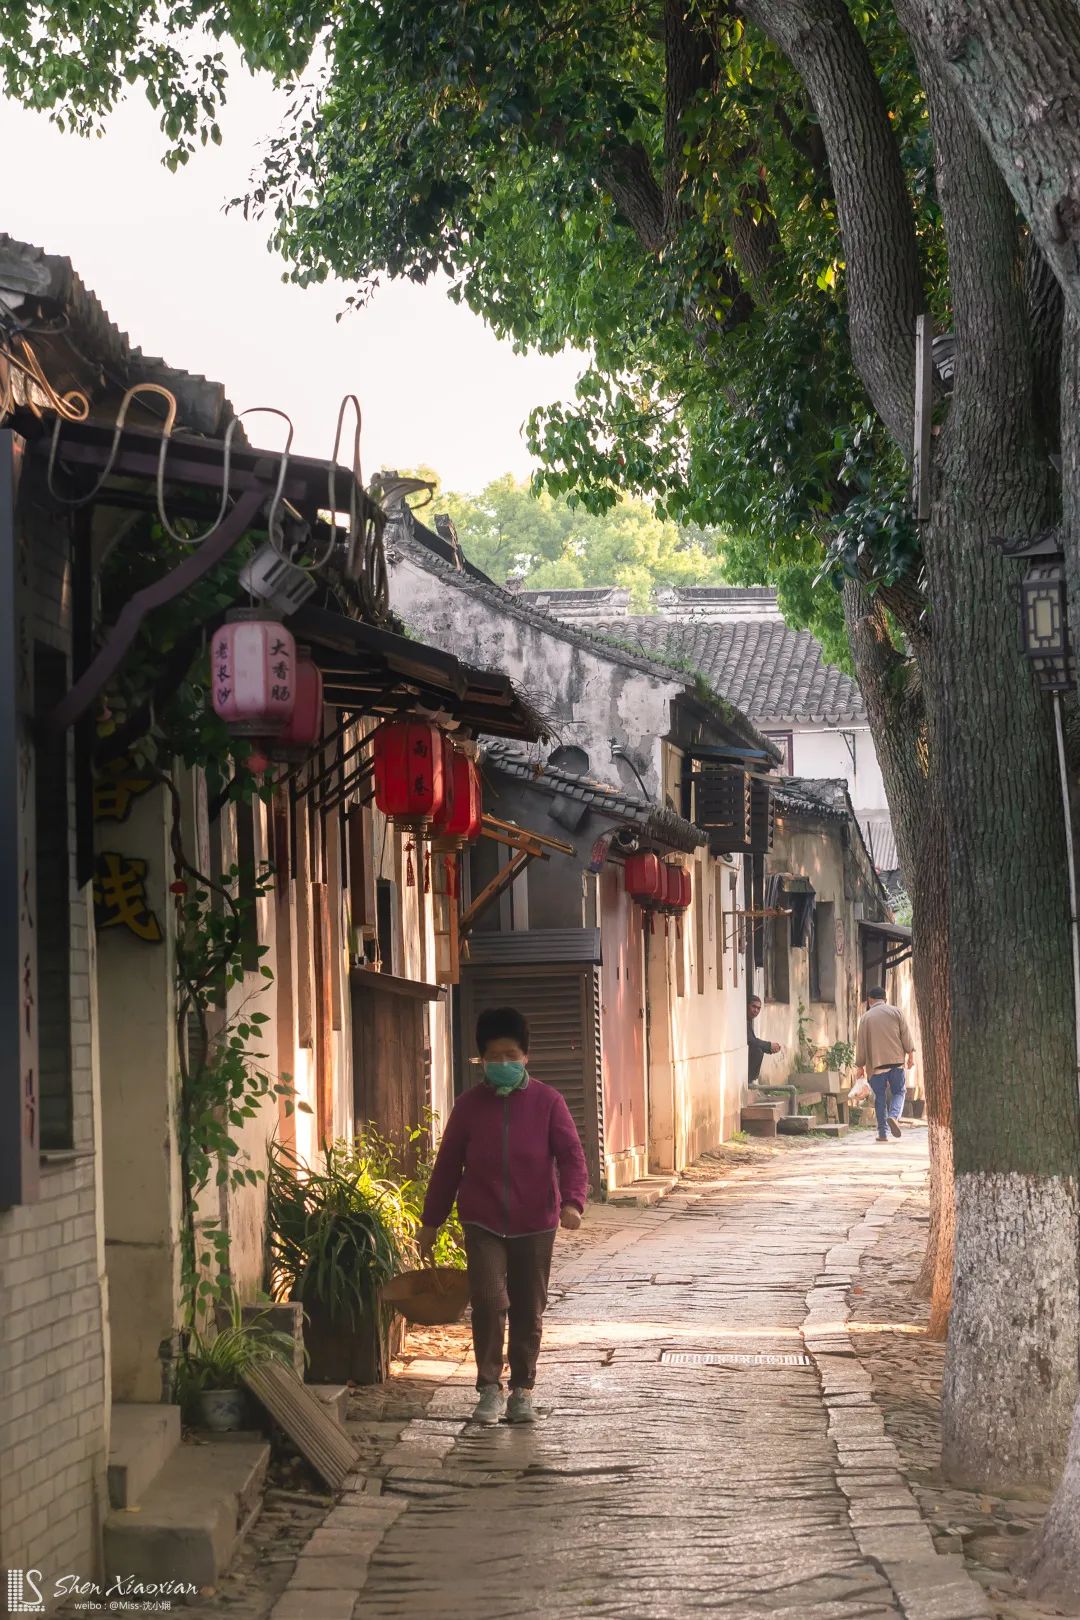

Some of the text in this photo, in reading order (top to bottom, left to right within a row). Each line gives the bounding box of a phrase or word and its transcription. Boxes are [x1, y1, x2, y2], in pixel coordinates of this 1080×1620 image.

[215, 641, 232, 706] 老长沙
[269, 638, 290, 702] 大香肠
